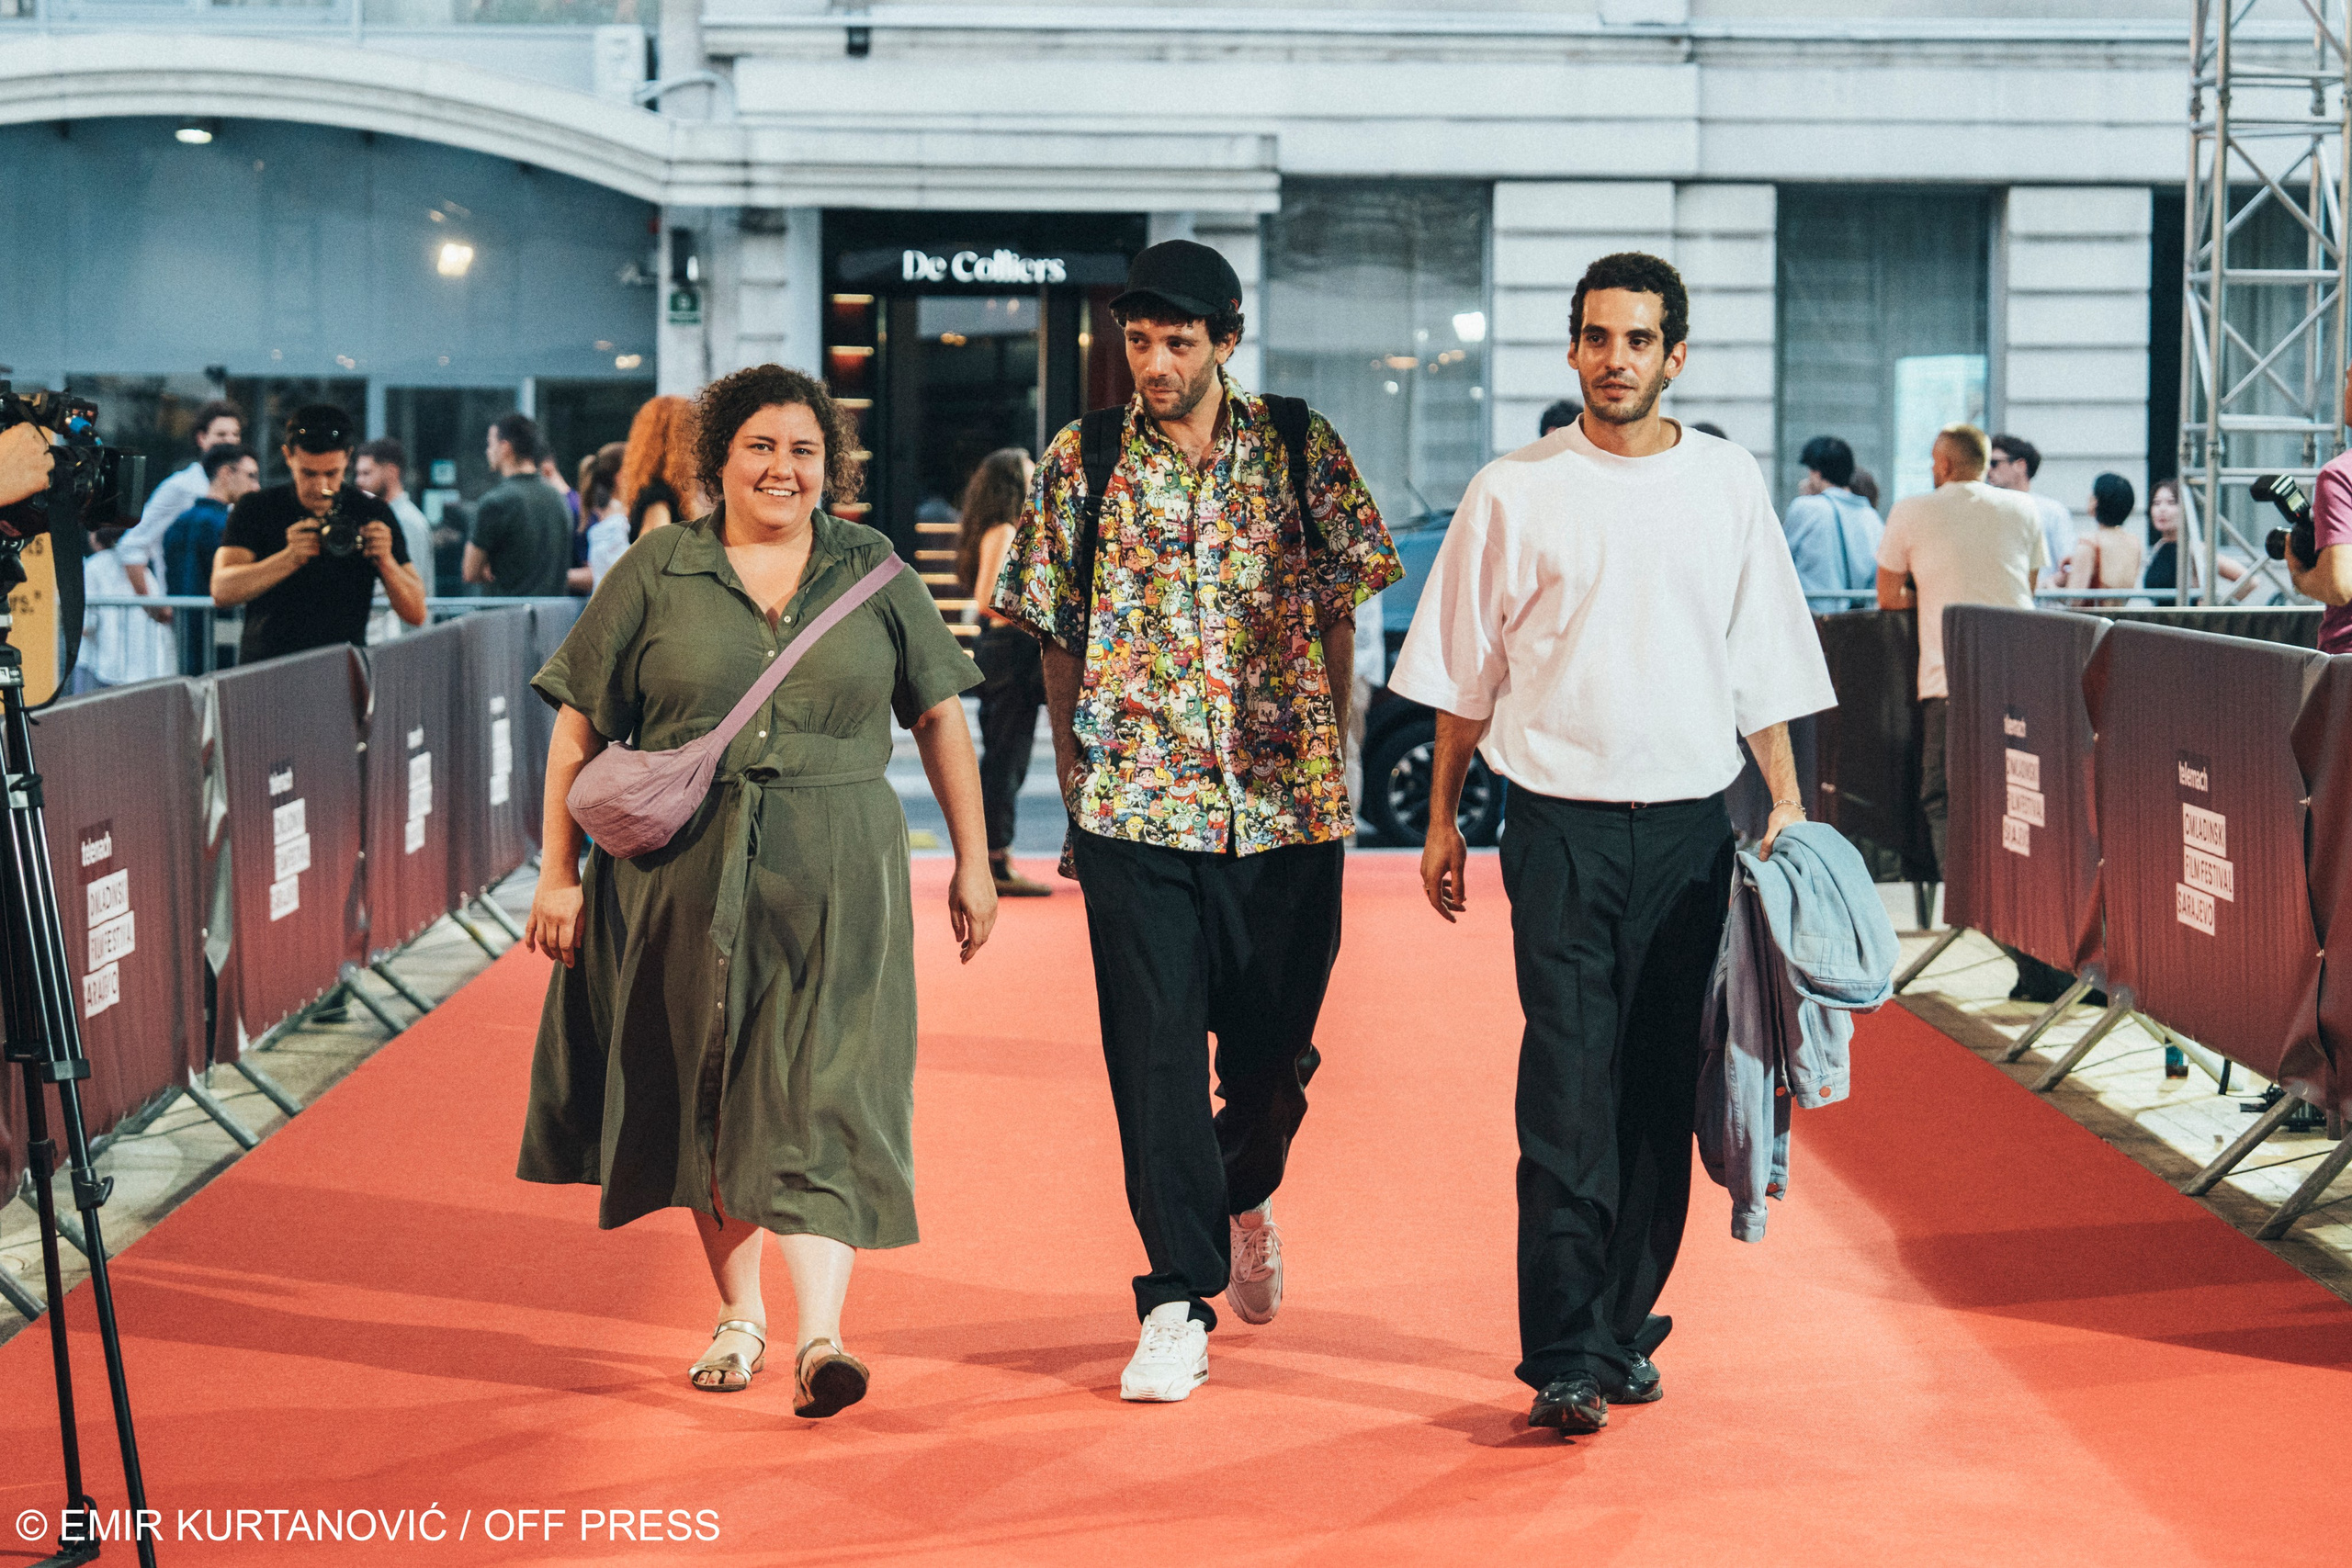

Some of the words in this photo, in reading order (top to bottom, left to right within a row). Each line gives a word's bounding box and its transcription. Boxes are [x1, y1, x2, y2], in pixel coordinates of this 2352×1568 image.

[902, 249, 947, 282] De
[951, 248, 1067, 284] Colliers
[2178, 761, 2209, 793] telemach
[2185, 813, 2225, 848] OMLADINSKI
[2186, 854, 2199, 881] FILM
[2200, 860, 2233, 894] FESTIVAL
[2177, 890, 2213, 927] SARAJEVO
